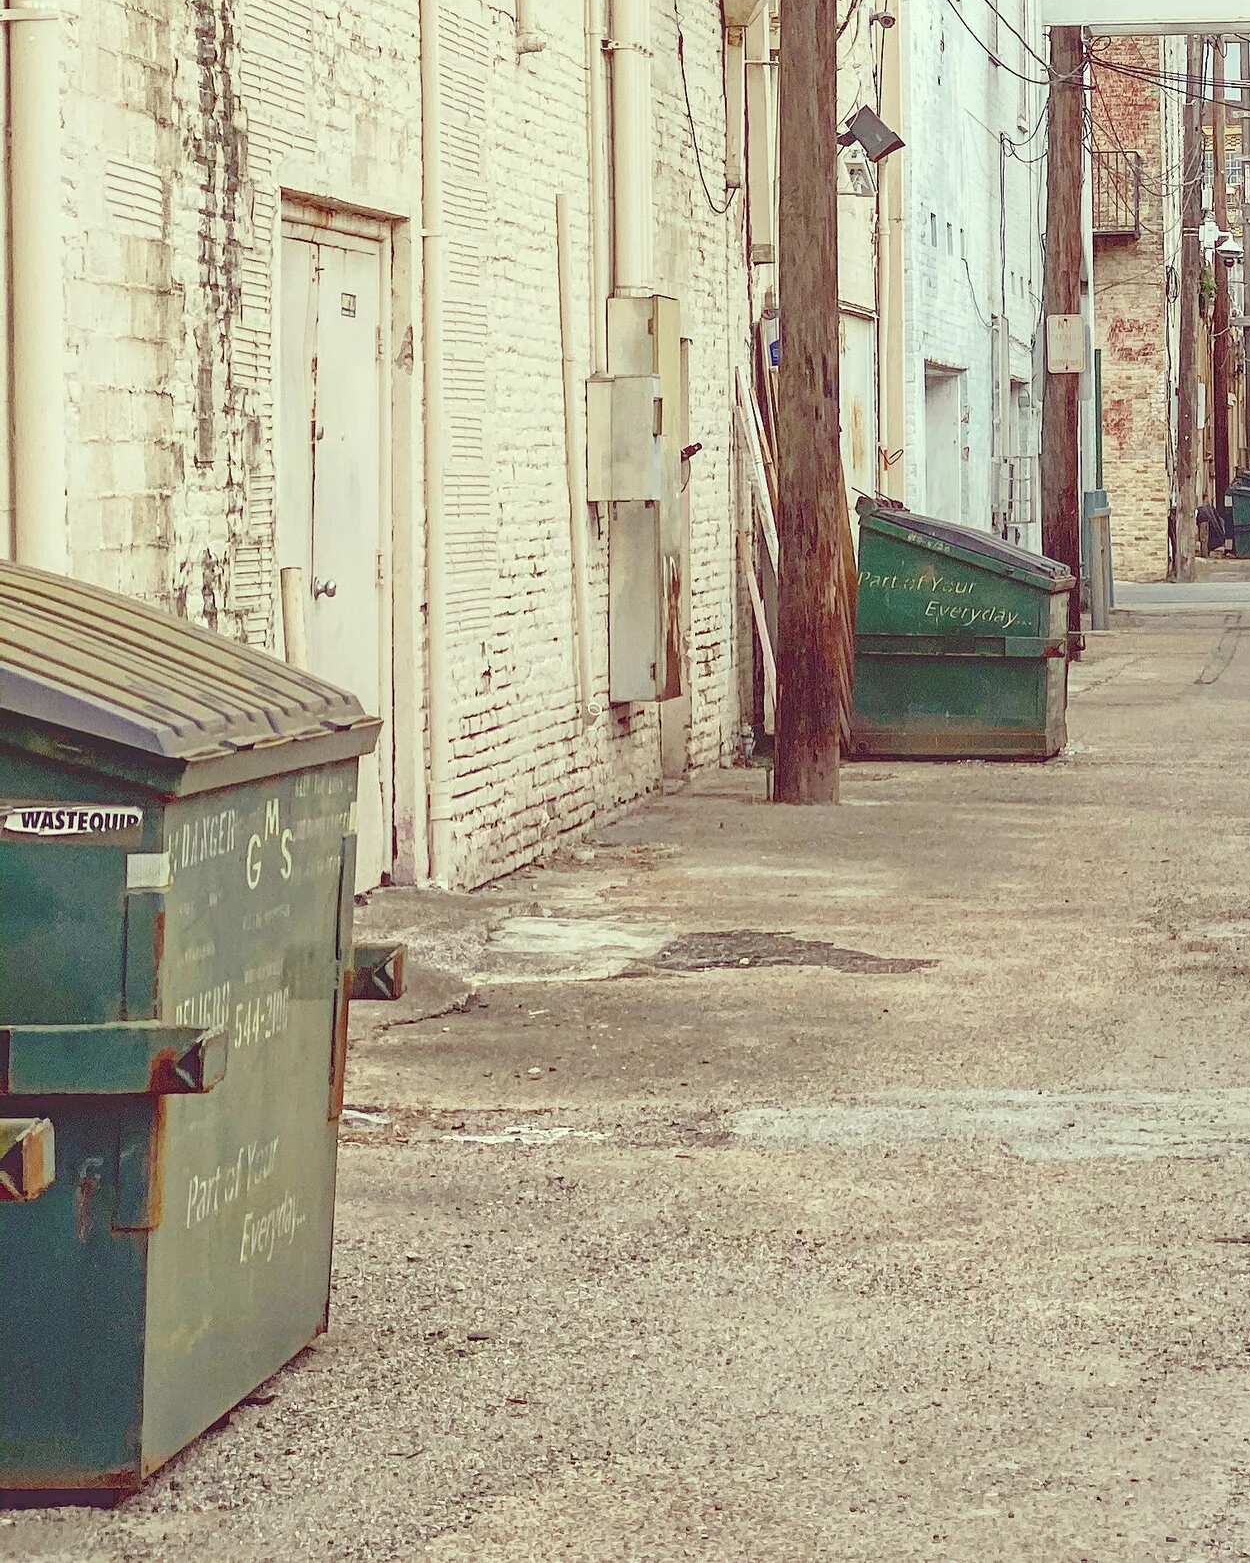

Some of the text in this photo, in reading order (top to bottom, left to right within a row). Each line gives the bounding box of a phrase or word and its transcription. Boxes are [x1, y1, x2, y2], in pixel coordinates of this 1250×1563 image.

[858, 571, 977, 594] Part of Your
[186, 1166, 222, 1230] Part
[224, 1147, 245, 1203] of
